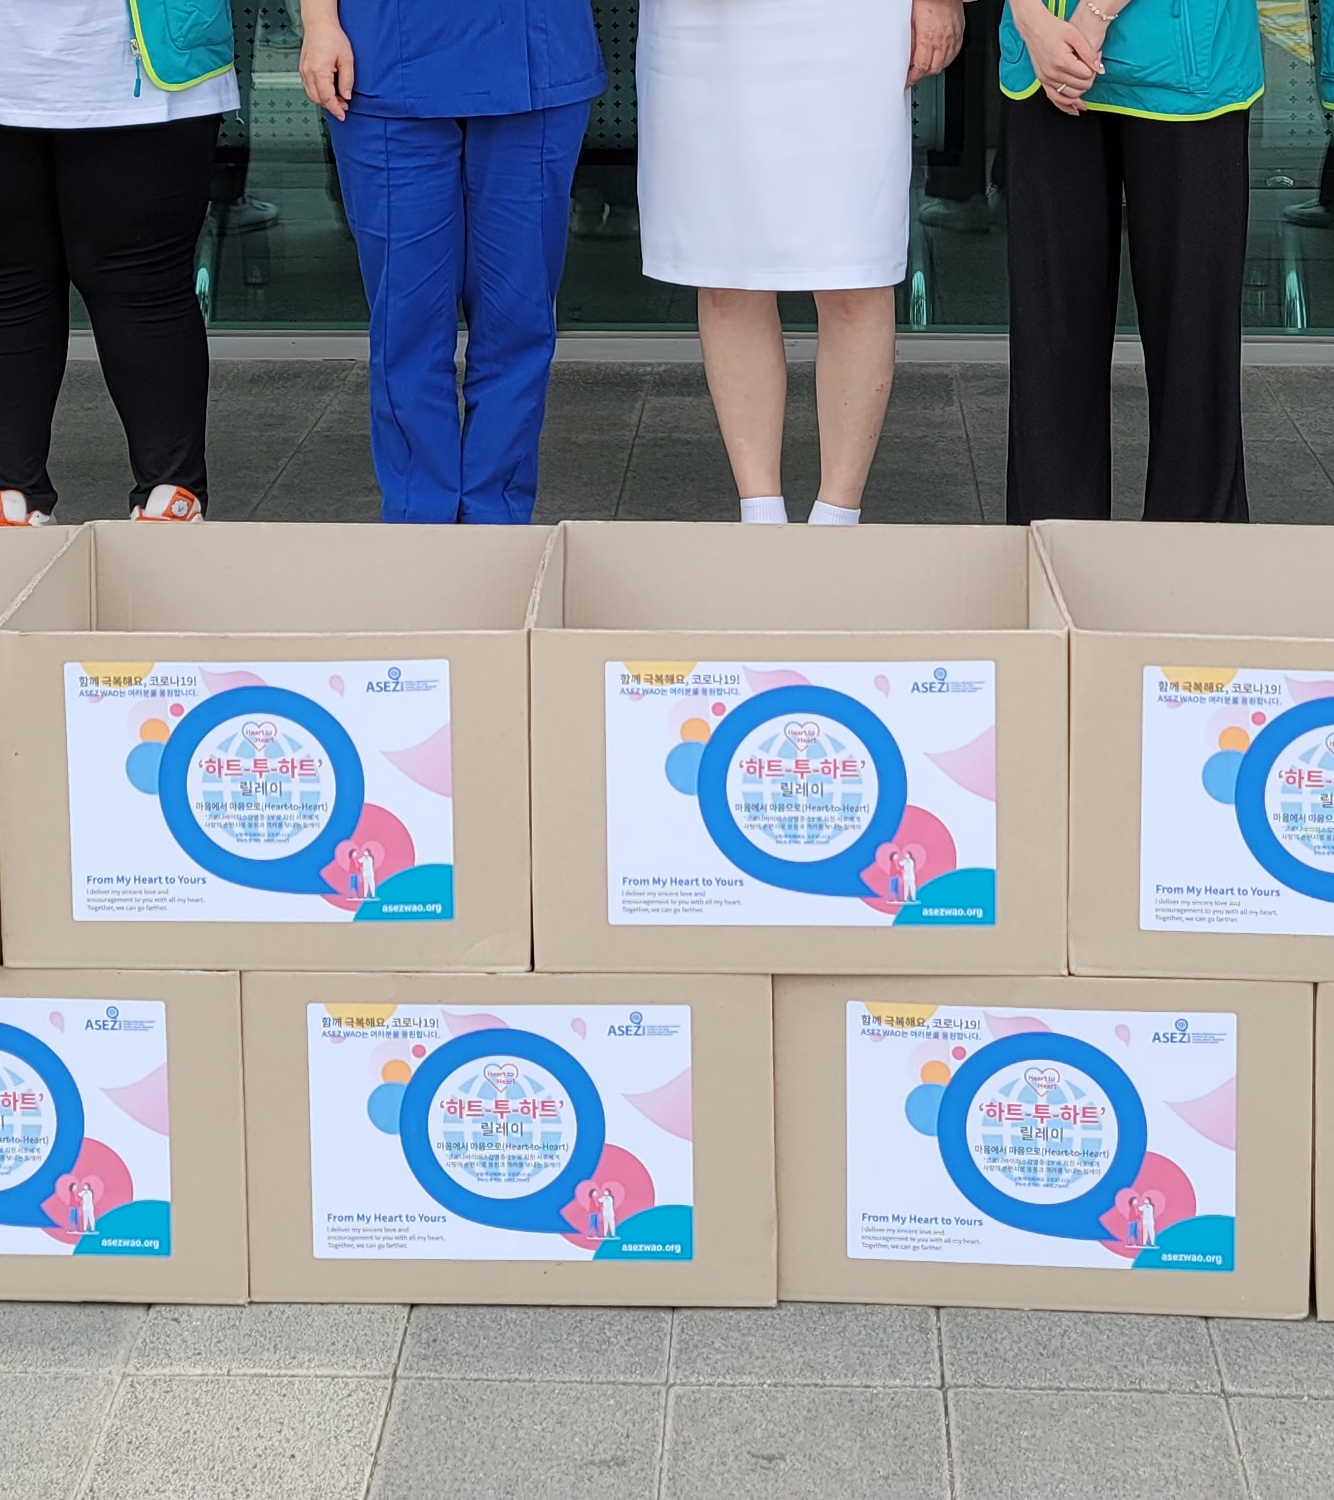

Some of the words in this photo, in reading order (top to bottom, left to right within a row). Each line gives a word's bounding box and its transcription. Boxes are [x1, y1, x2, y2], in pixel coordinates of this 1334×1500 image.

[79, 675, 99, 687] 함께
[149, 675, 196, 686] 코로나19!
[620, 673, 640, 685] 함께
[691, 673, 739, 685] 코로나19!
[1158, 680, 1179, 692] 함께
[1231, 682, 1281, 695] 코로나19!
[239, 781, 282, 796] 릴레이
[780, 782, 823, 797] 릴레이
[86, 875, 114, 884] From
[116, 875, 131, 886] My
[133, 875, 162, 884] Heart
[165, 876, 175, 884] to
[177, 875, 206, 884] Yours
[622, 876, 649, 886] From
[652, 876, 667, 888] My
[670, 877, 699, 886] Heart
[702, 877, 712, 886] to
[715, 877, 744, 886] Yours
[1155, 884, 1183, 894] From
[1186, 885, 1202, 896] My
[1204, 885, 1234, 895] Heart
[1237, 887, 1248, 896] to
[1250, 887, 1280, 896] Yours
[381, 903, 441, 914] asezwao.org
[921, 907, 982, 918] asezwao.org
[322, 1016, 342, 1027] 함께
[391, 1017, 439, 1028] 코로나19!
[861, 1015, 881, 1027] 함께
[932, 1017, 980, 1030] 코로나19!
[481, 1121, 523, 1136] 릴레이
[1020, 1125, 1063, 1142] 릴레이
[327, 1213, 354, 1222] From
[356, 1213, 371, 1224] My
[374, 1213, 403, 1222] Heart
[405, 1214, 416, 1222] to
[418, 1213, 446, 1222] Yours
[861, 1213, 889, 1223] From
[891, 1214, 906, 1225] My
[909, 1214, 938, 1224] Heart
[941, 1216, 952, 1225] to
[954, 1216, 983, 1226] Yours
[101, 1237, 159, 1248] asezwao.org
[621, 1243, 681, 1253] asezwao.org
[1160, 1252, 1221, 1265] asezwao.org
